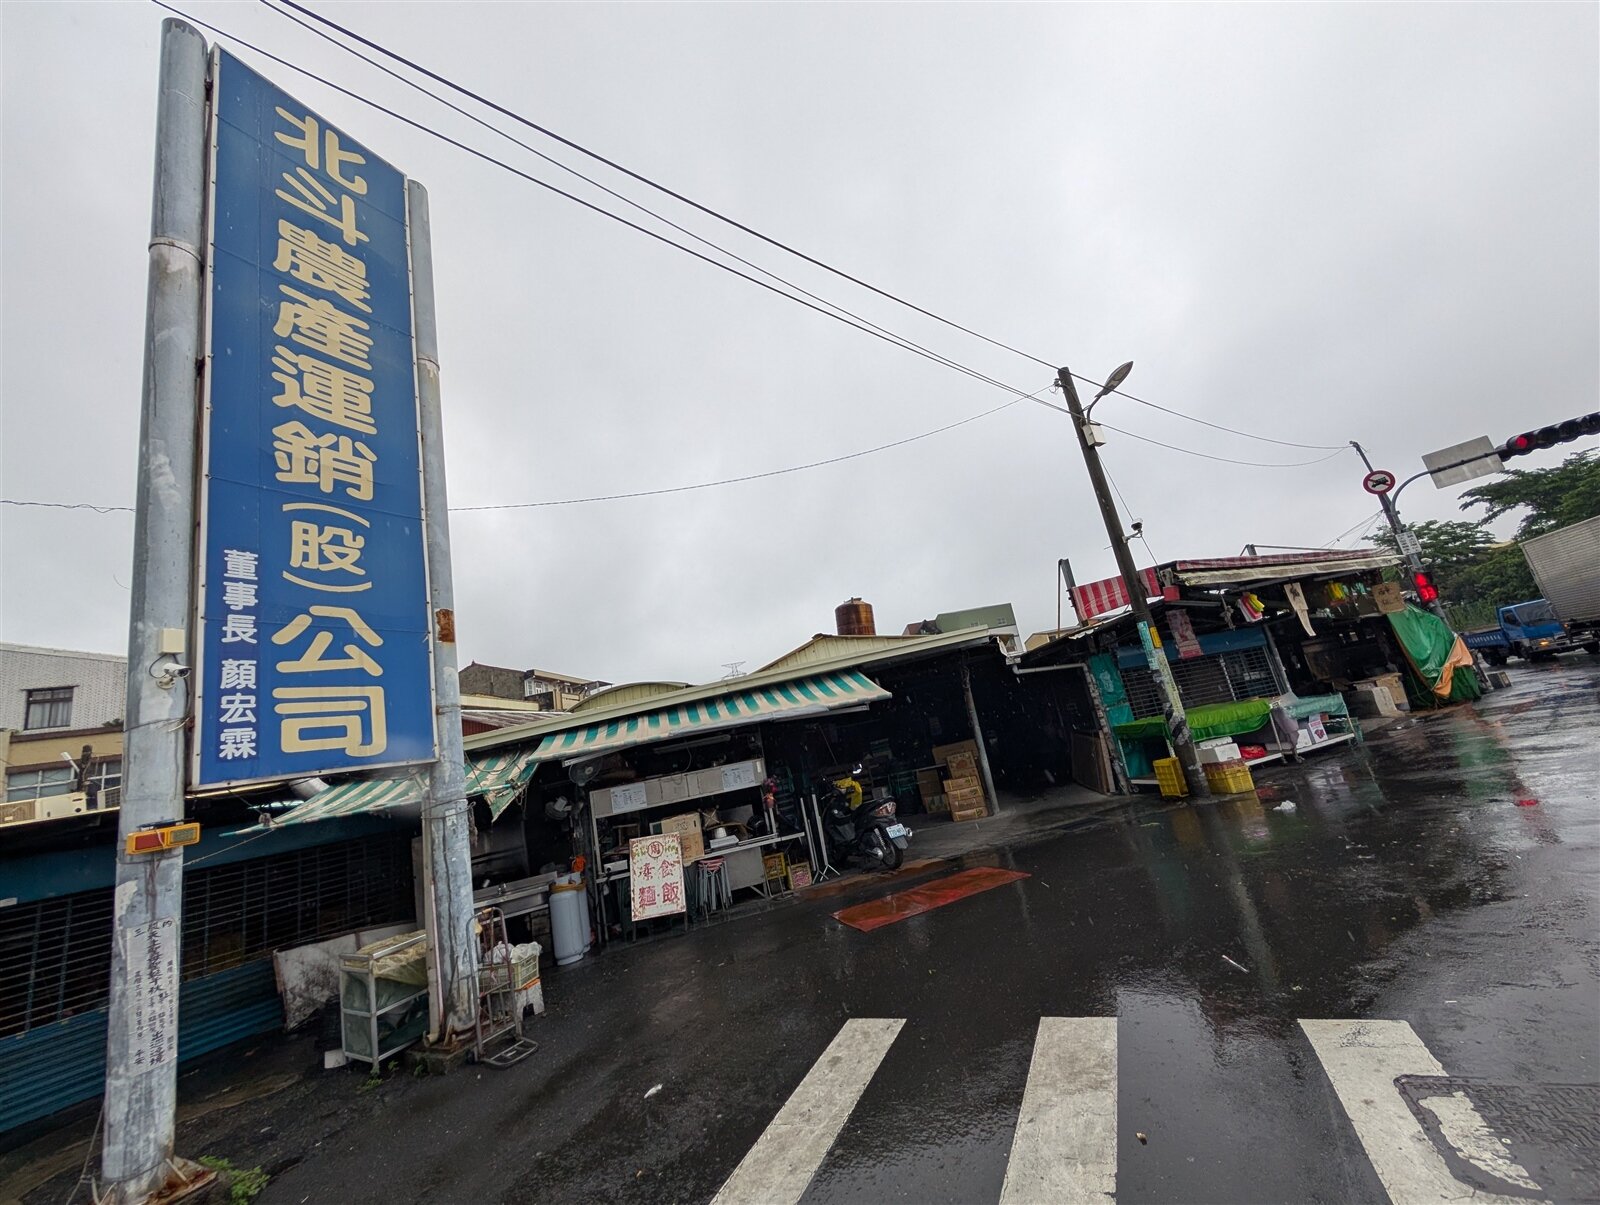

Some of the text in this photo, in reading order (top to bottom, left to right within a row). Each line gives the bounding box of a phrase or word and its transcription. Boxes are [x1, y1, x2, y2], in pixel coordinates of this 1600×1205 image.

[219, 549, 259, 760] 董事長 顏宏霖
